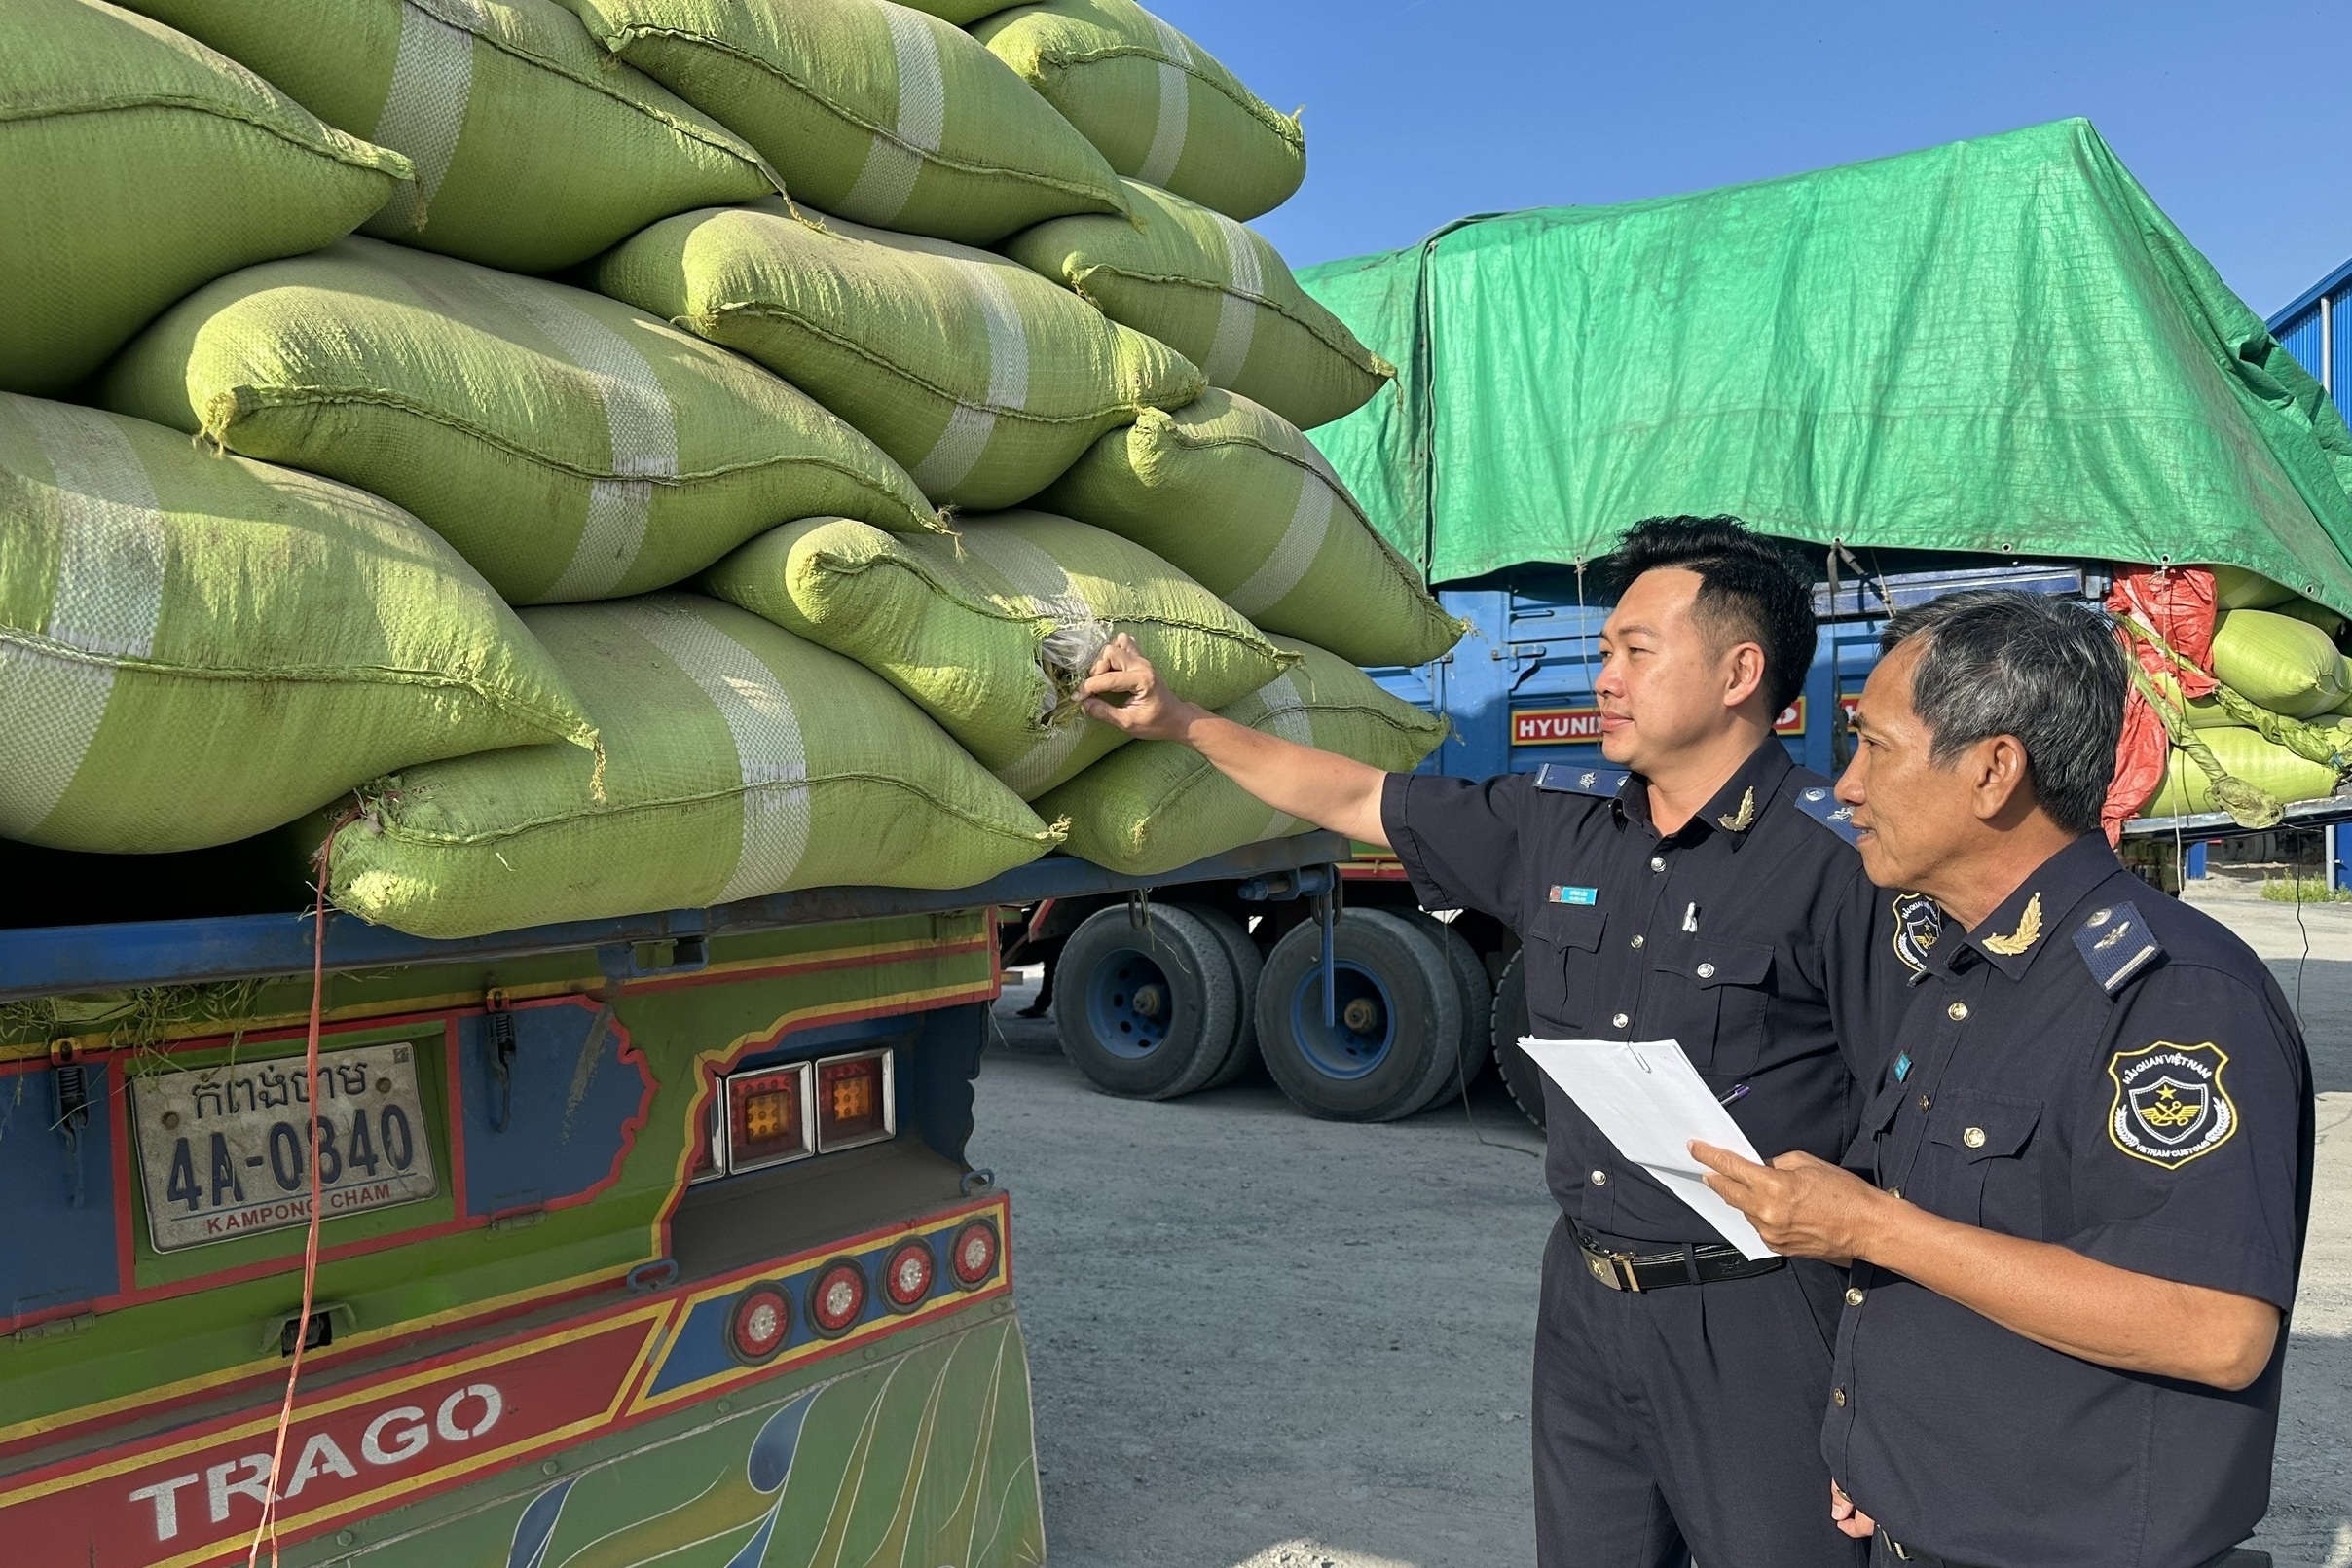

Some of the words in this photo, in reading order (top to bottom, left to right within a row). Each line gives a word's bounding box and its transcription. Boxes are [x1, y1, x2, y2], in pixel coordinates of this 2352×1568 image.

[2136, 1054, 2164, 1073] QUAN
[2164, 1052, 2189, 1066] VIỆT
[2187, 1059, 2212, 1079] NAM
[330, 1184, 390, 1209] CHAM
[129, 1383, 502, 1542] TRAGO
